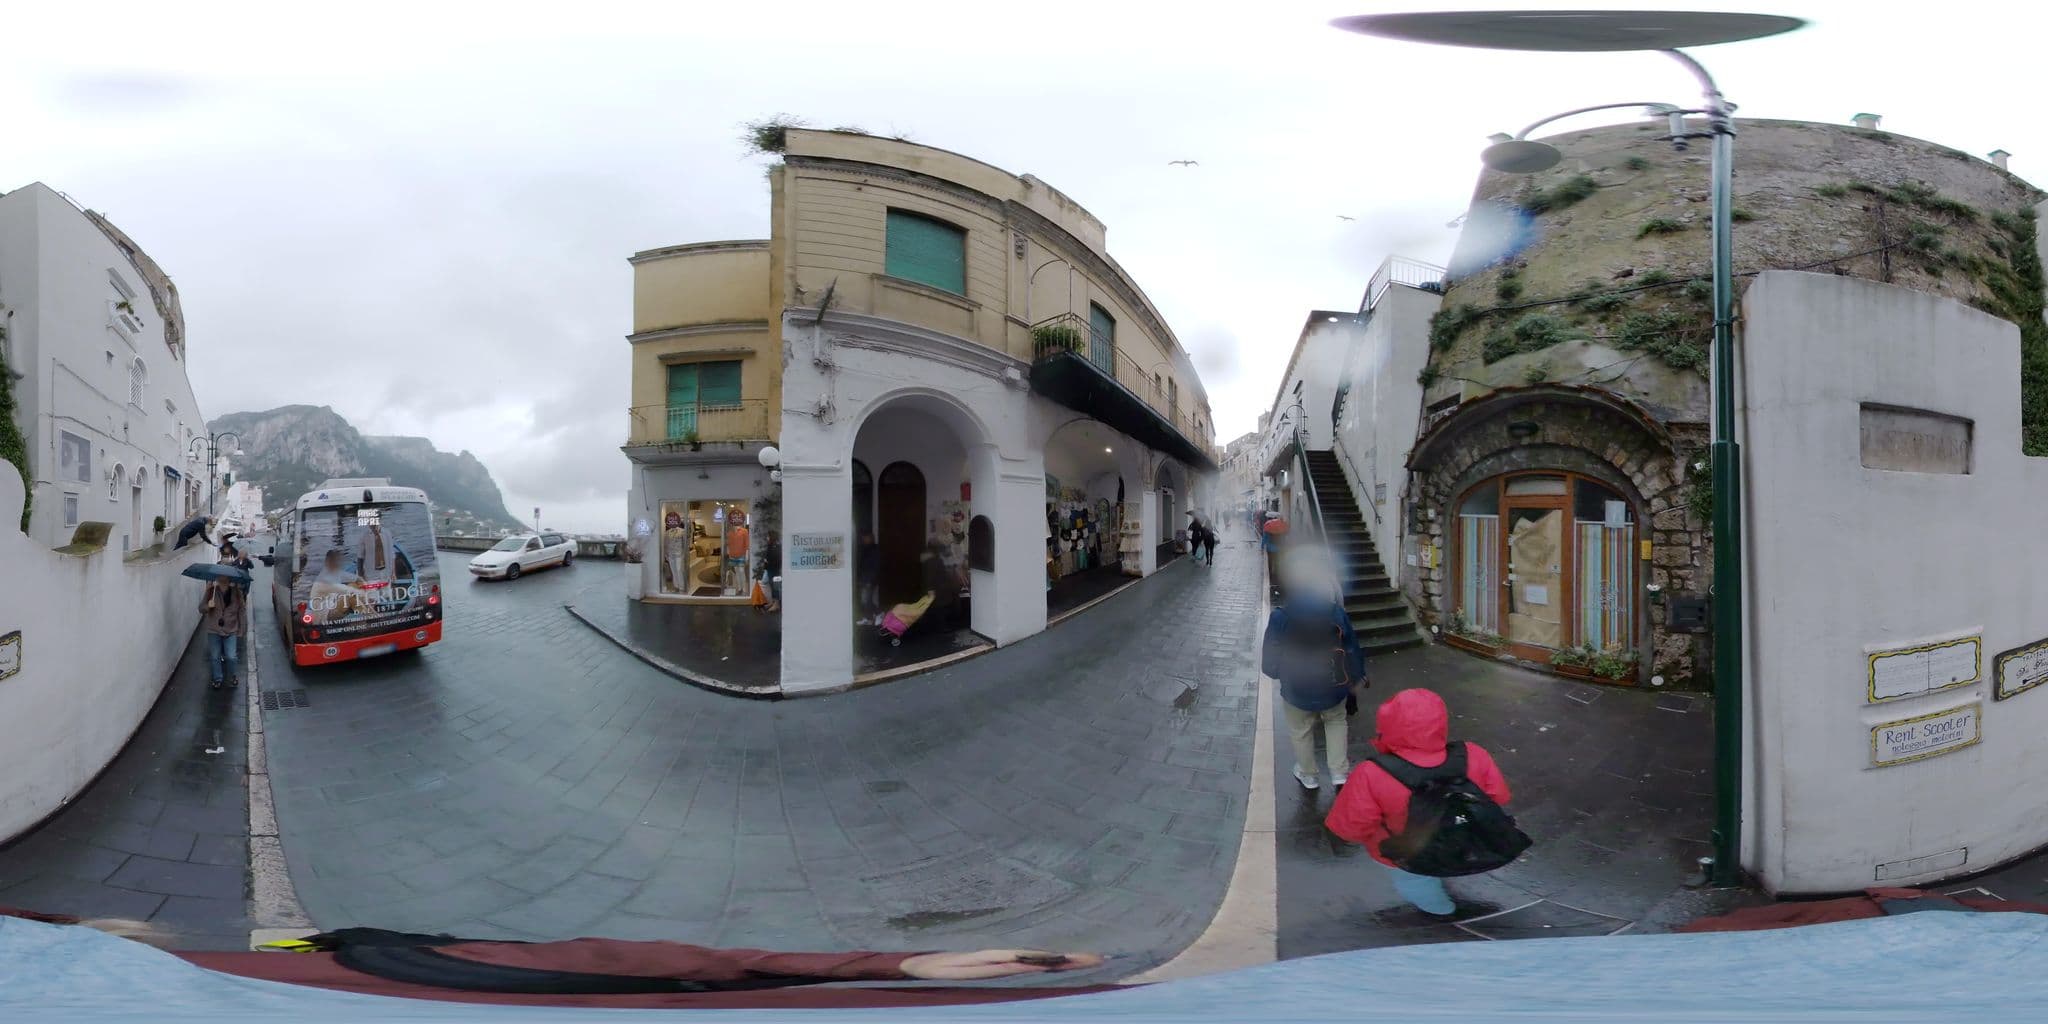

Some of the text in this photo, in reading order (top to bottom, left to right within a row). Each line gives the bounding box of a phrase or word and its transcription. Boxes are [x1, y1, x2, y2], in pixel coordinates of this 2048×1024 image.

[309, 582, 429, 611] GUTTERIDGE
[343, 623, 367, 633] ONLINE
[1886, 715, 1971, 744] Rent Scooter
